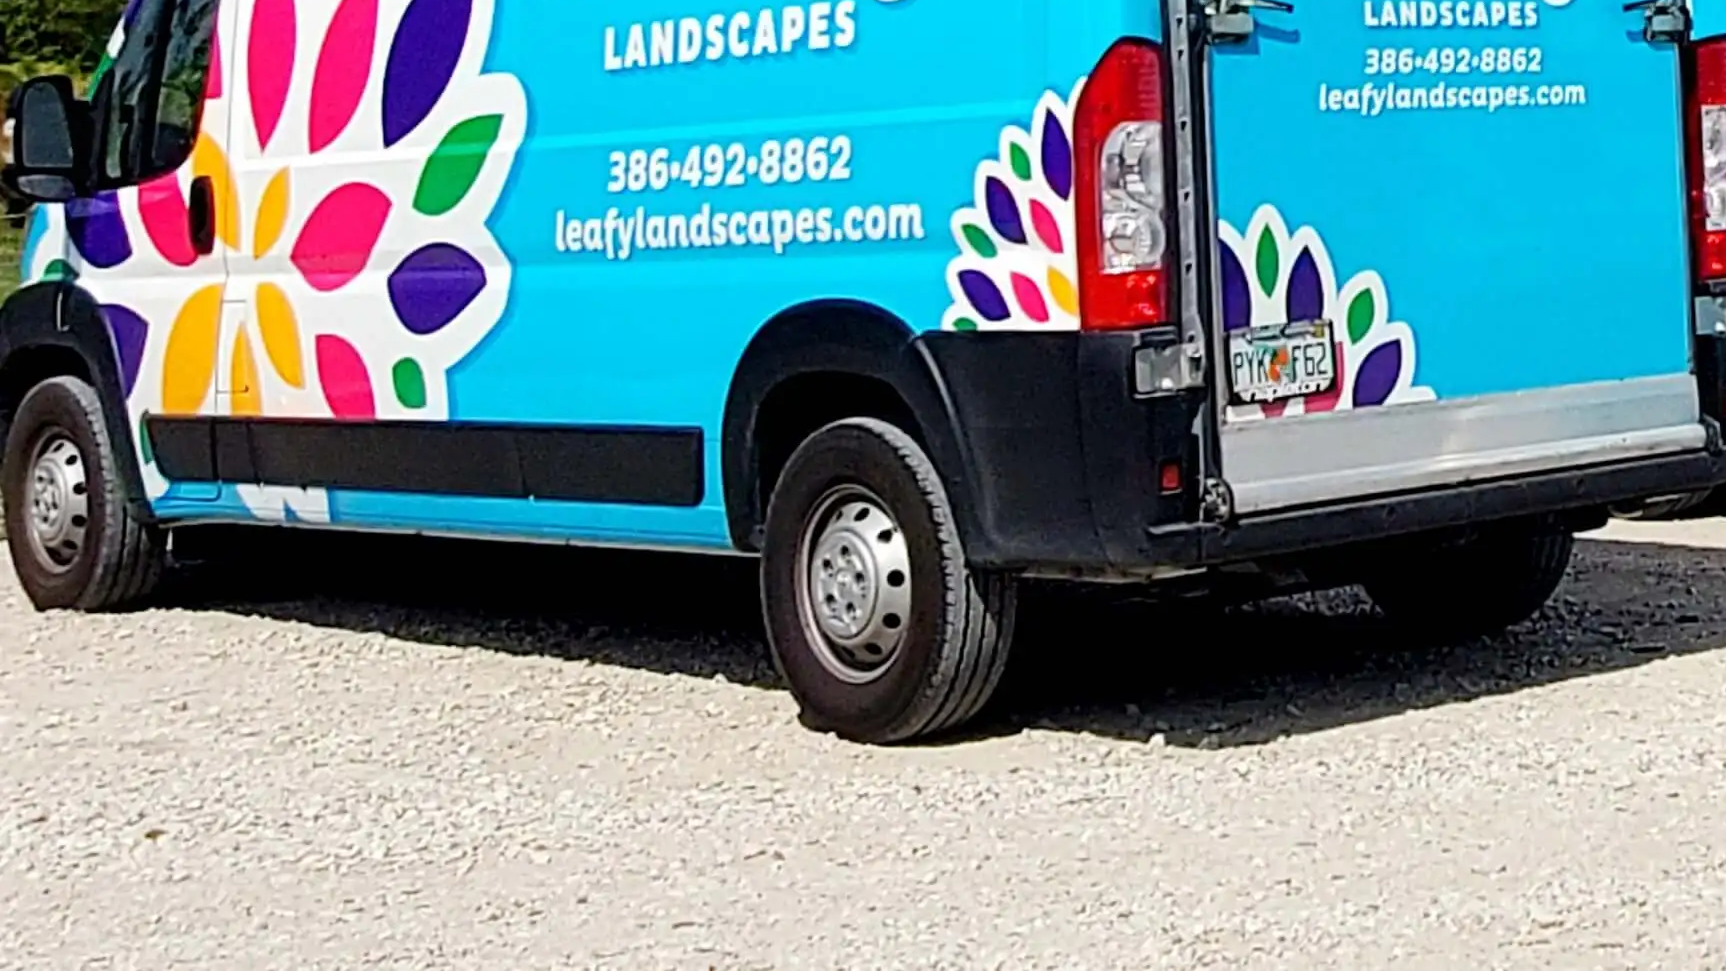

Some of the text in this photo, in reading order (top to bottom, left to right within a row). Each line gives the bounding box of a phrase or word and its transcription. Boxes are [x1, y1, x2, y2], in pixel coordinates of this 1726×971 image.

[604, 0, 856, 71] LANDSCAPES
[1363, 0, 1538, 27] LANDSCAPES
[1319, 81, 1586, 116] leafylandscapes.com
[555, 201, 925, 260] leafylandscapes.com
